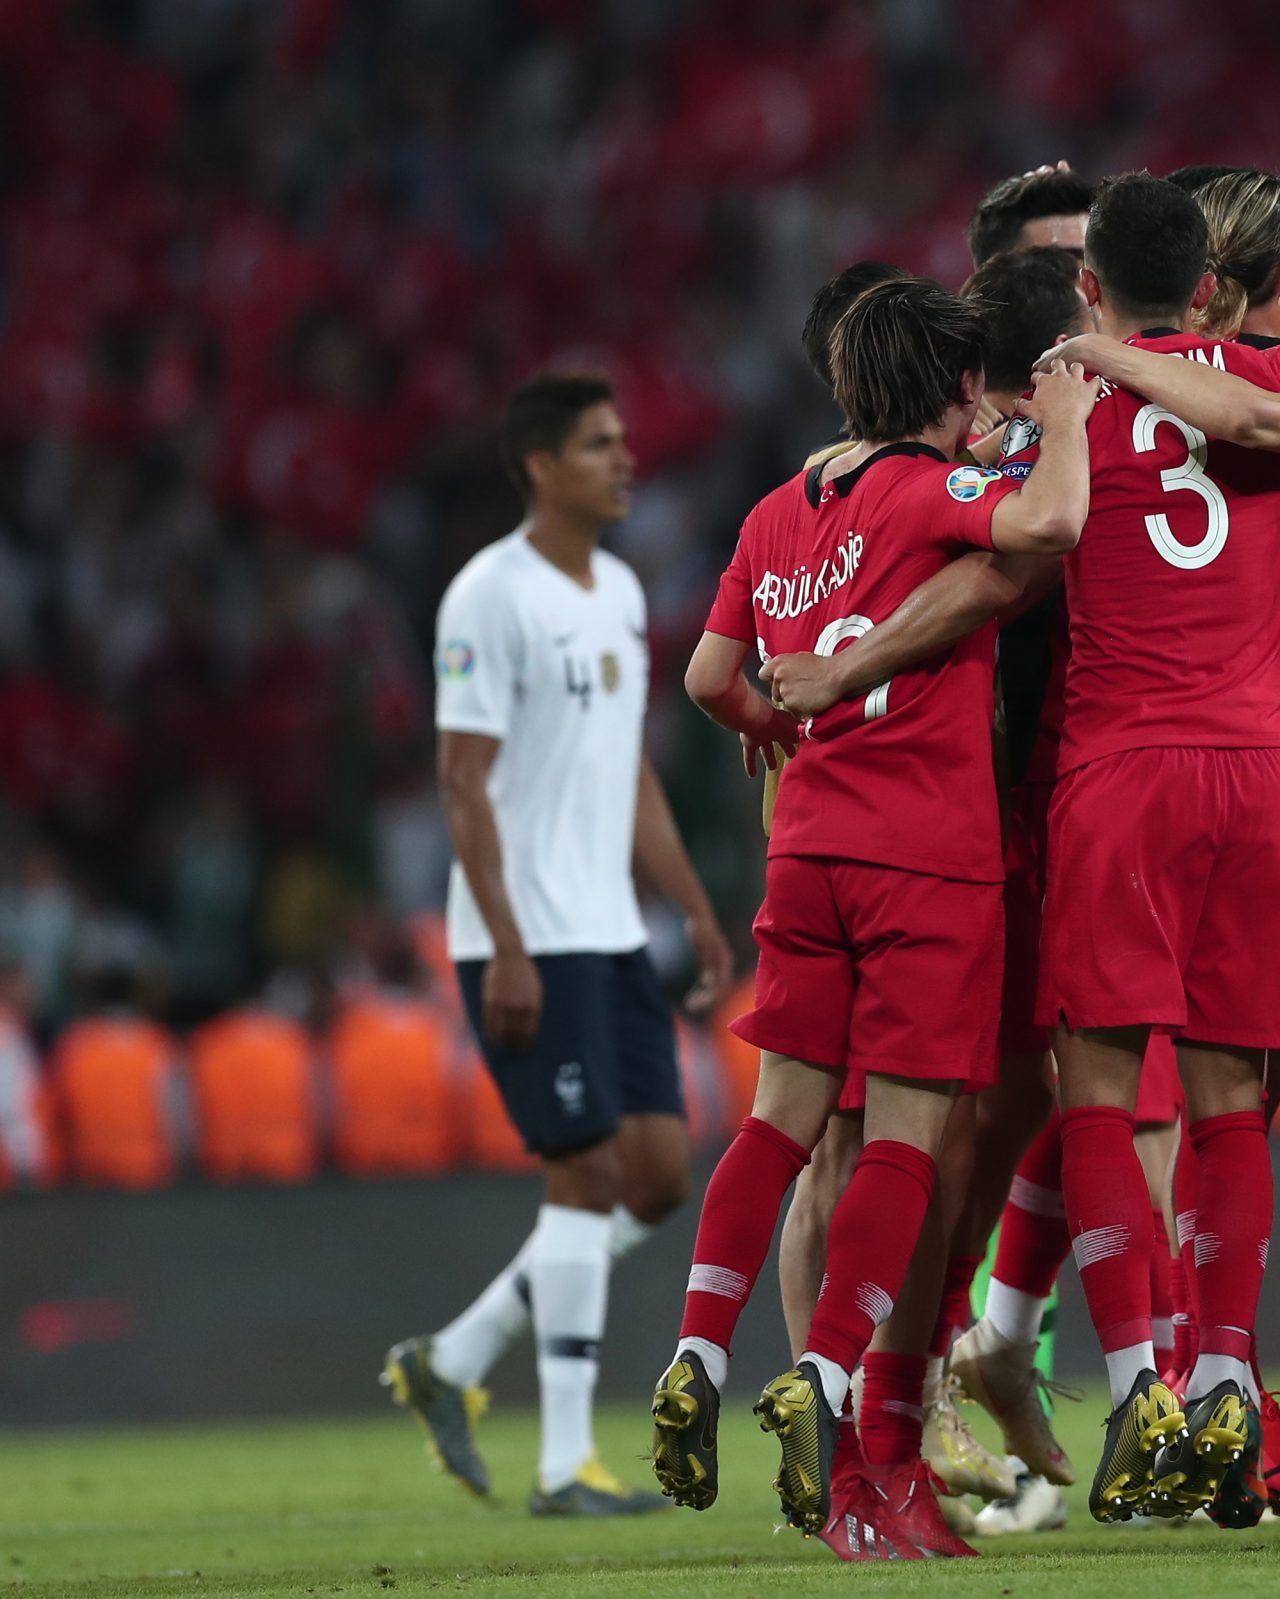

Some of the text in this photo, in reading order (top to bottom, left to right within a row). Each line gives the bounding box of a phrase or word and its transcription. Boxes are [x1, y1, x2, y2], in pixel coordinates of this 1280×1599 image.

[1002, 466, 1031, 477] ESPE
[1132, 404, 1229, 569] 3
[564, 652, 592, 713] 4
